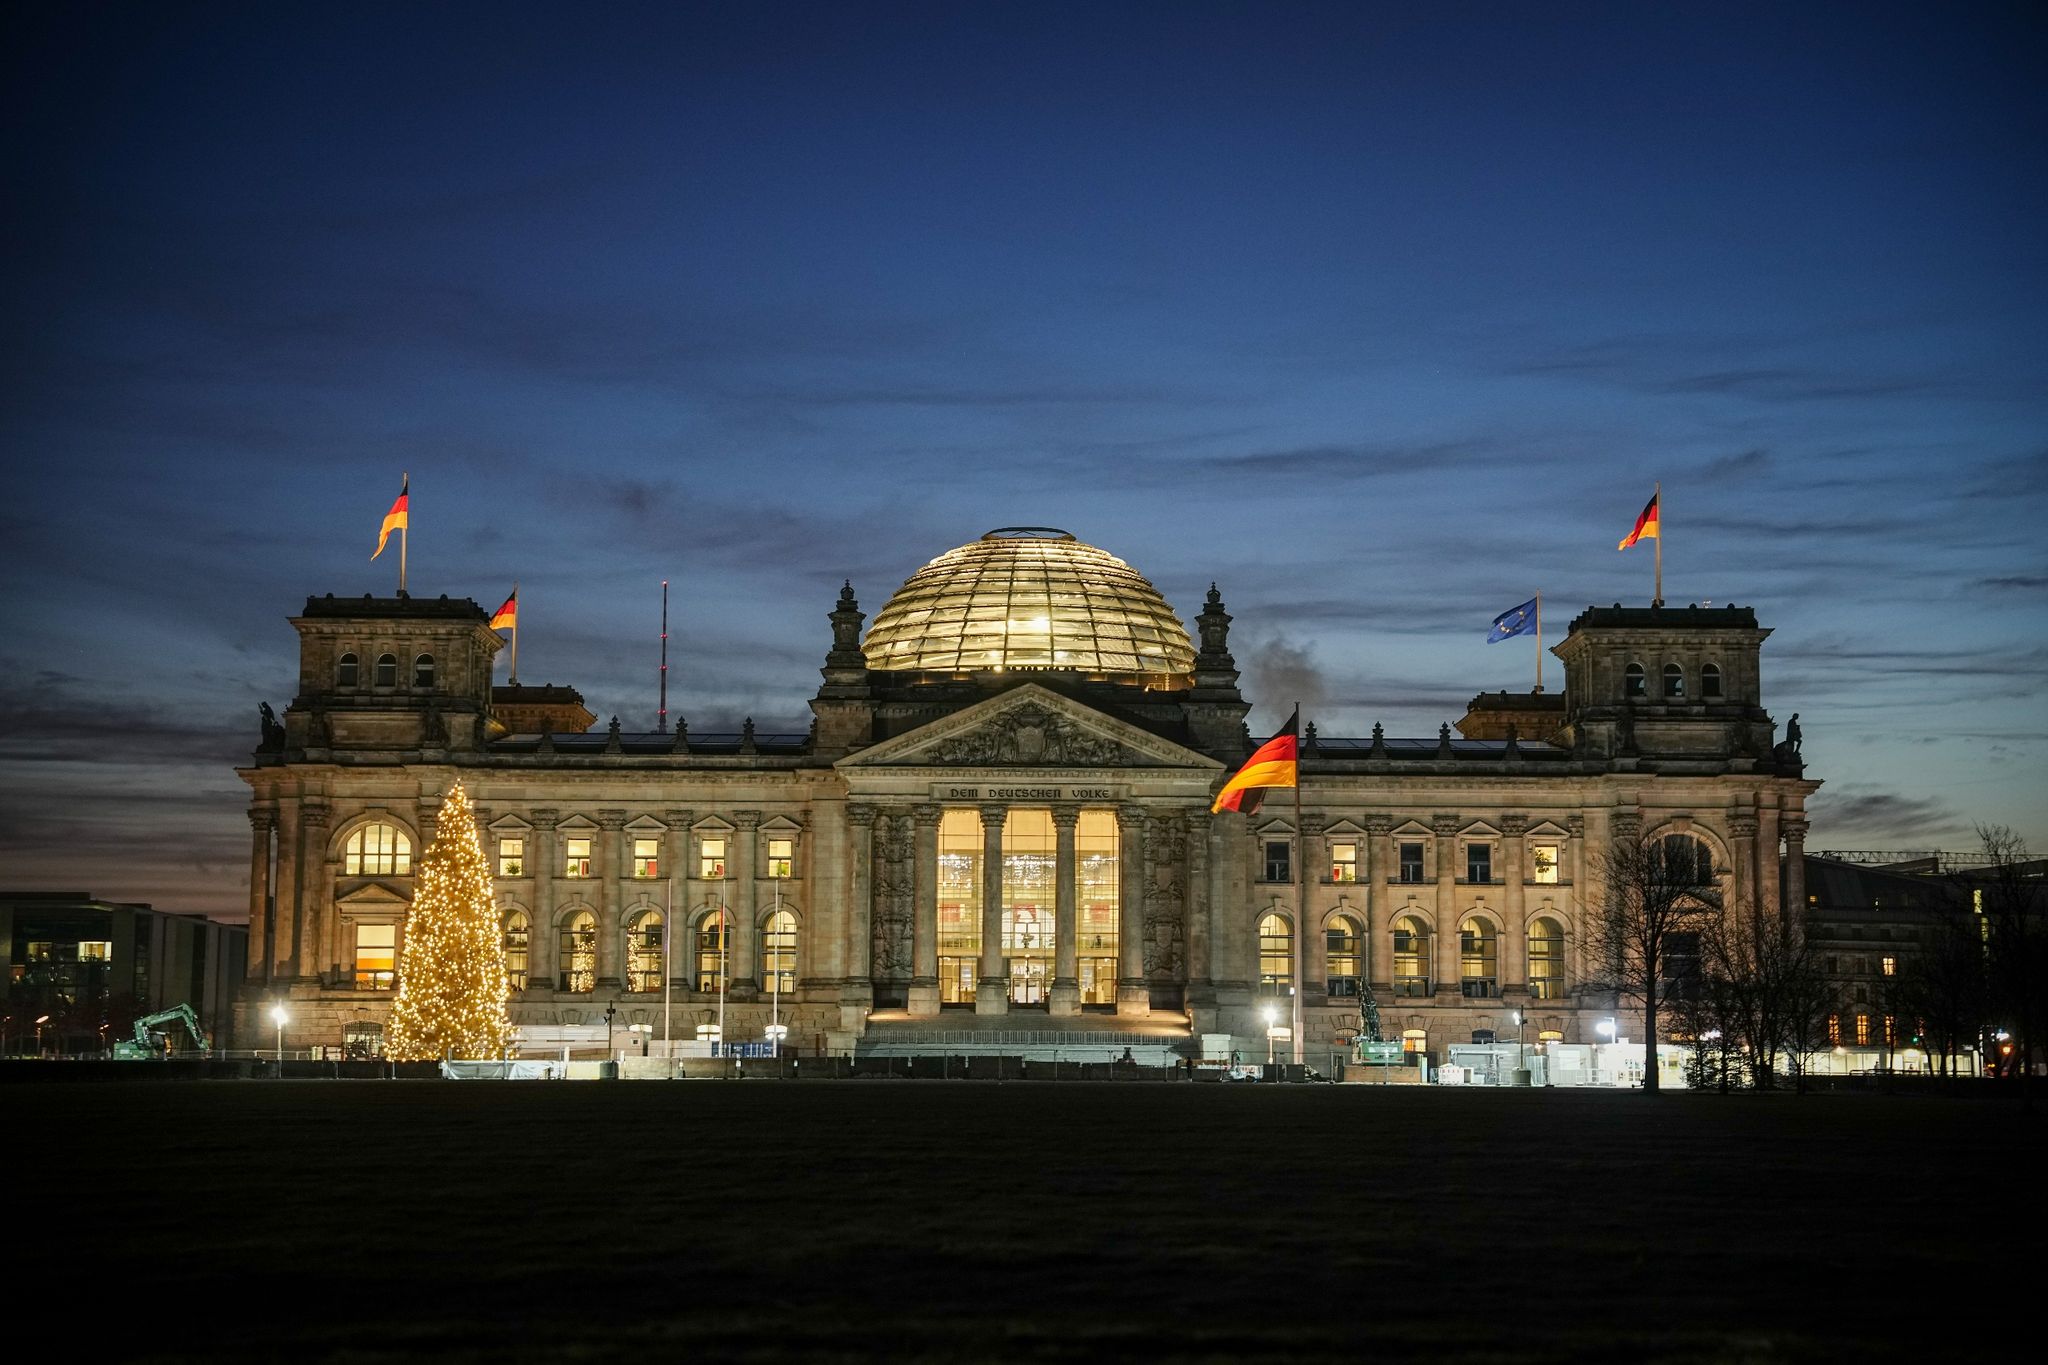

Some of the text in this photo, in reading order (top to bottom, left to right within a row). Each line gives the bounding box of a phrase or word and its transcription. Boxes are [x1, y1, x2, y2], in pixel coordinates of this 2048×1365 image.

[950, 788, 1110, 798] DEM DEUTSCHEN VOLKE
